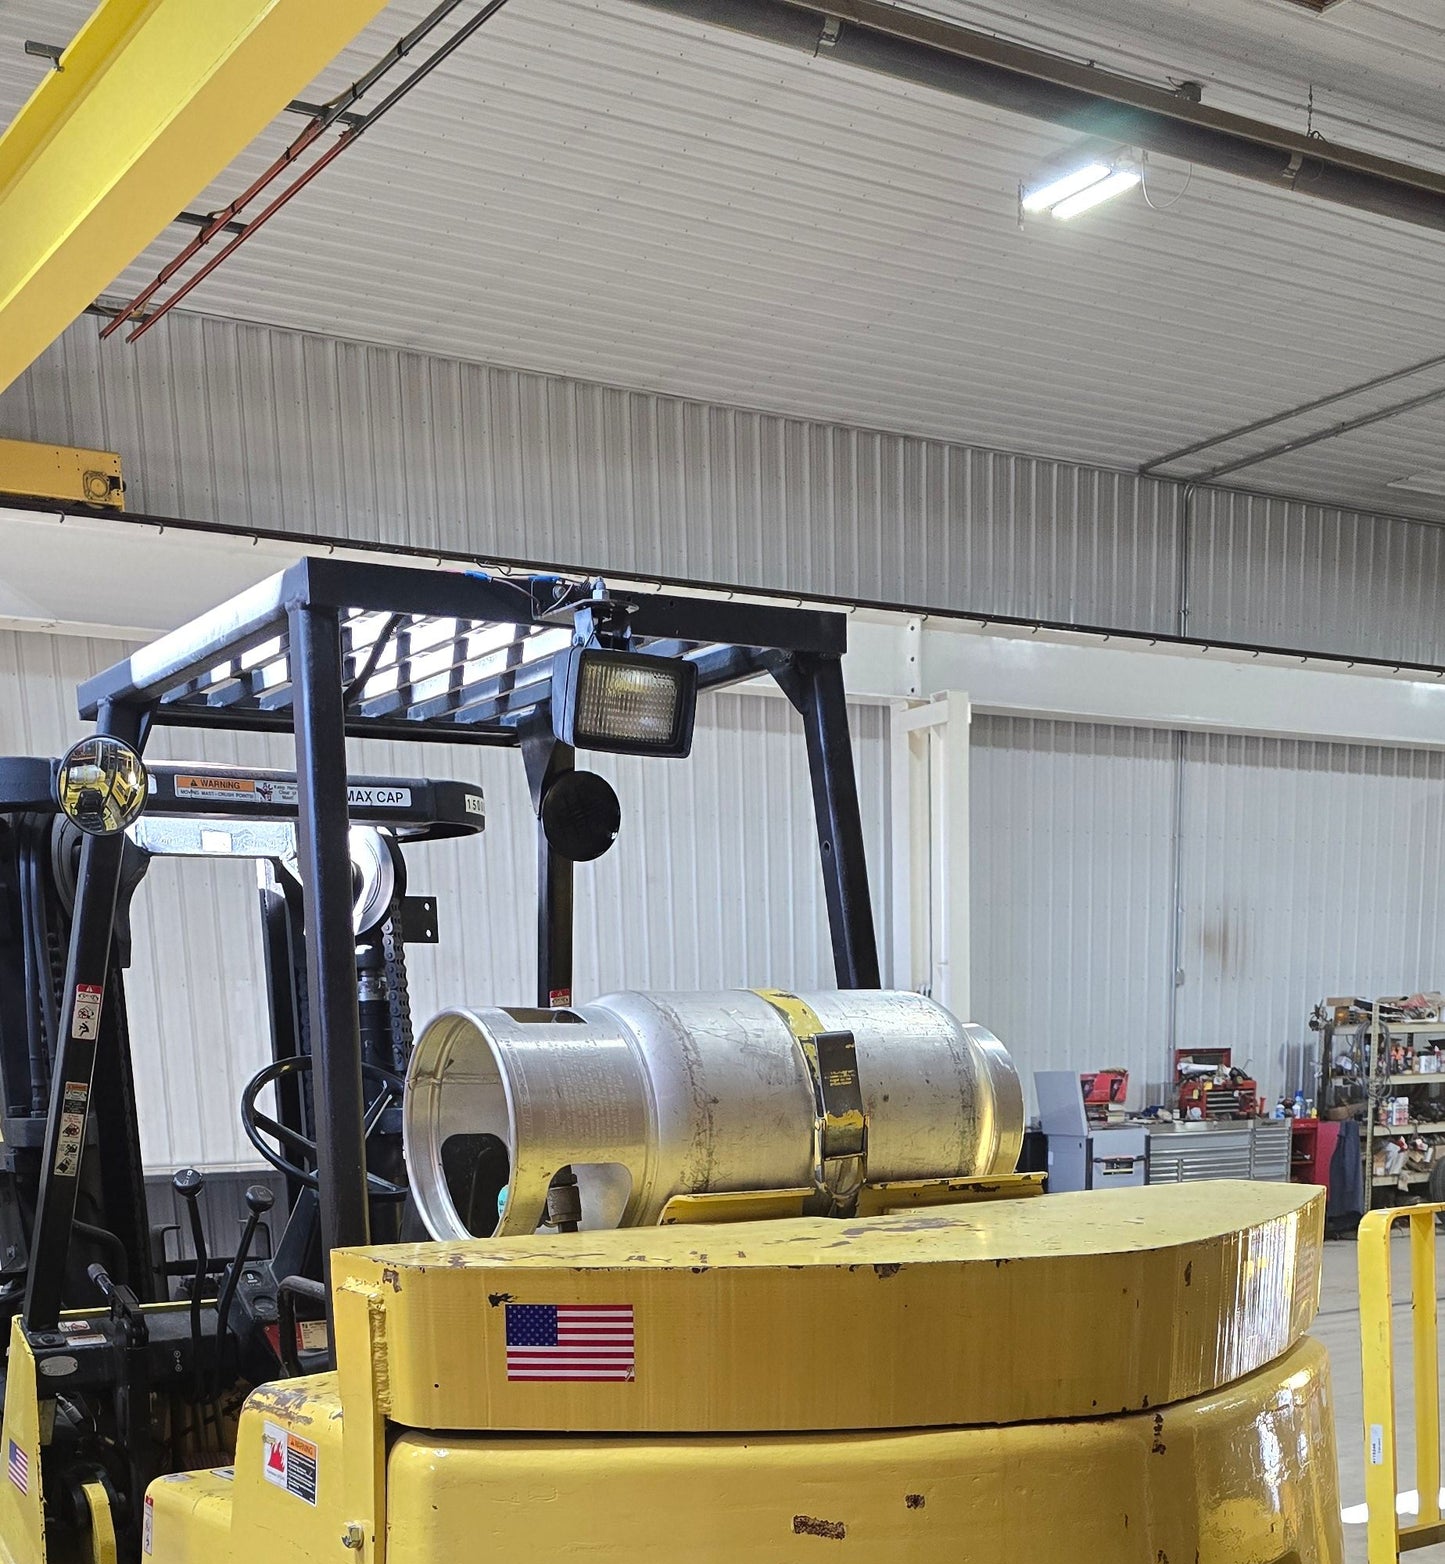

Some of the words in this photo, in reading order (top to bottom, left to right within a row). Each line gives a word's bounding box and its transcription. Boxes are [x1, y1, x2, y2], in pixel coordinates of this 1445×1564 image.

[200, 779, 241, 790] WARNING
[347, 790, 373, 803] MAX
[376, 791, 404, 803] CAP
